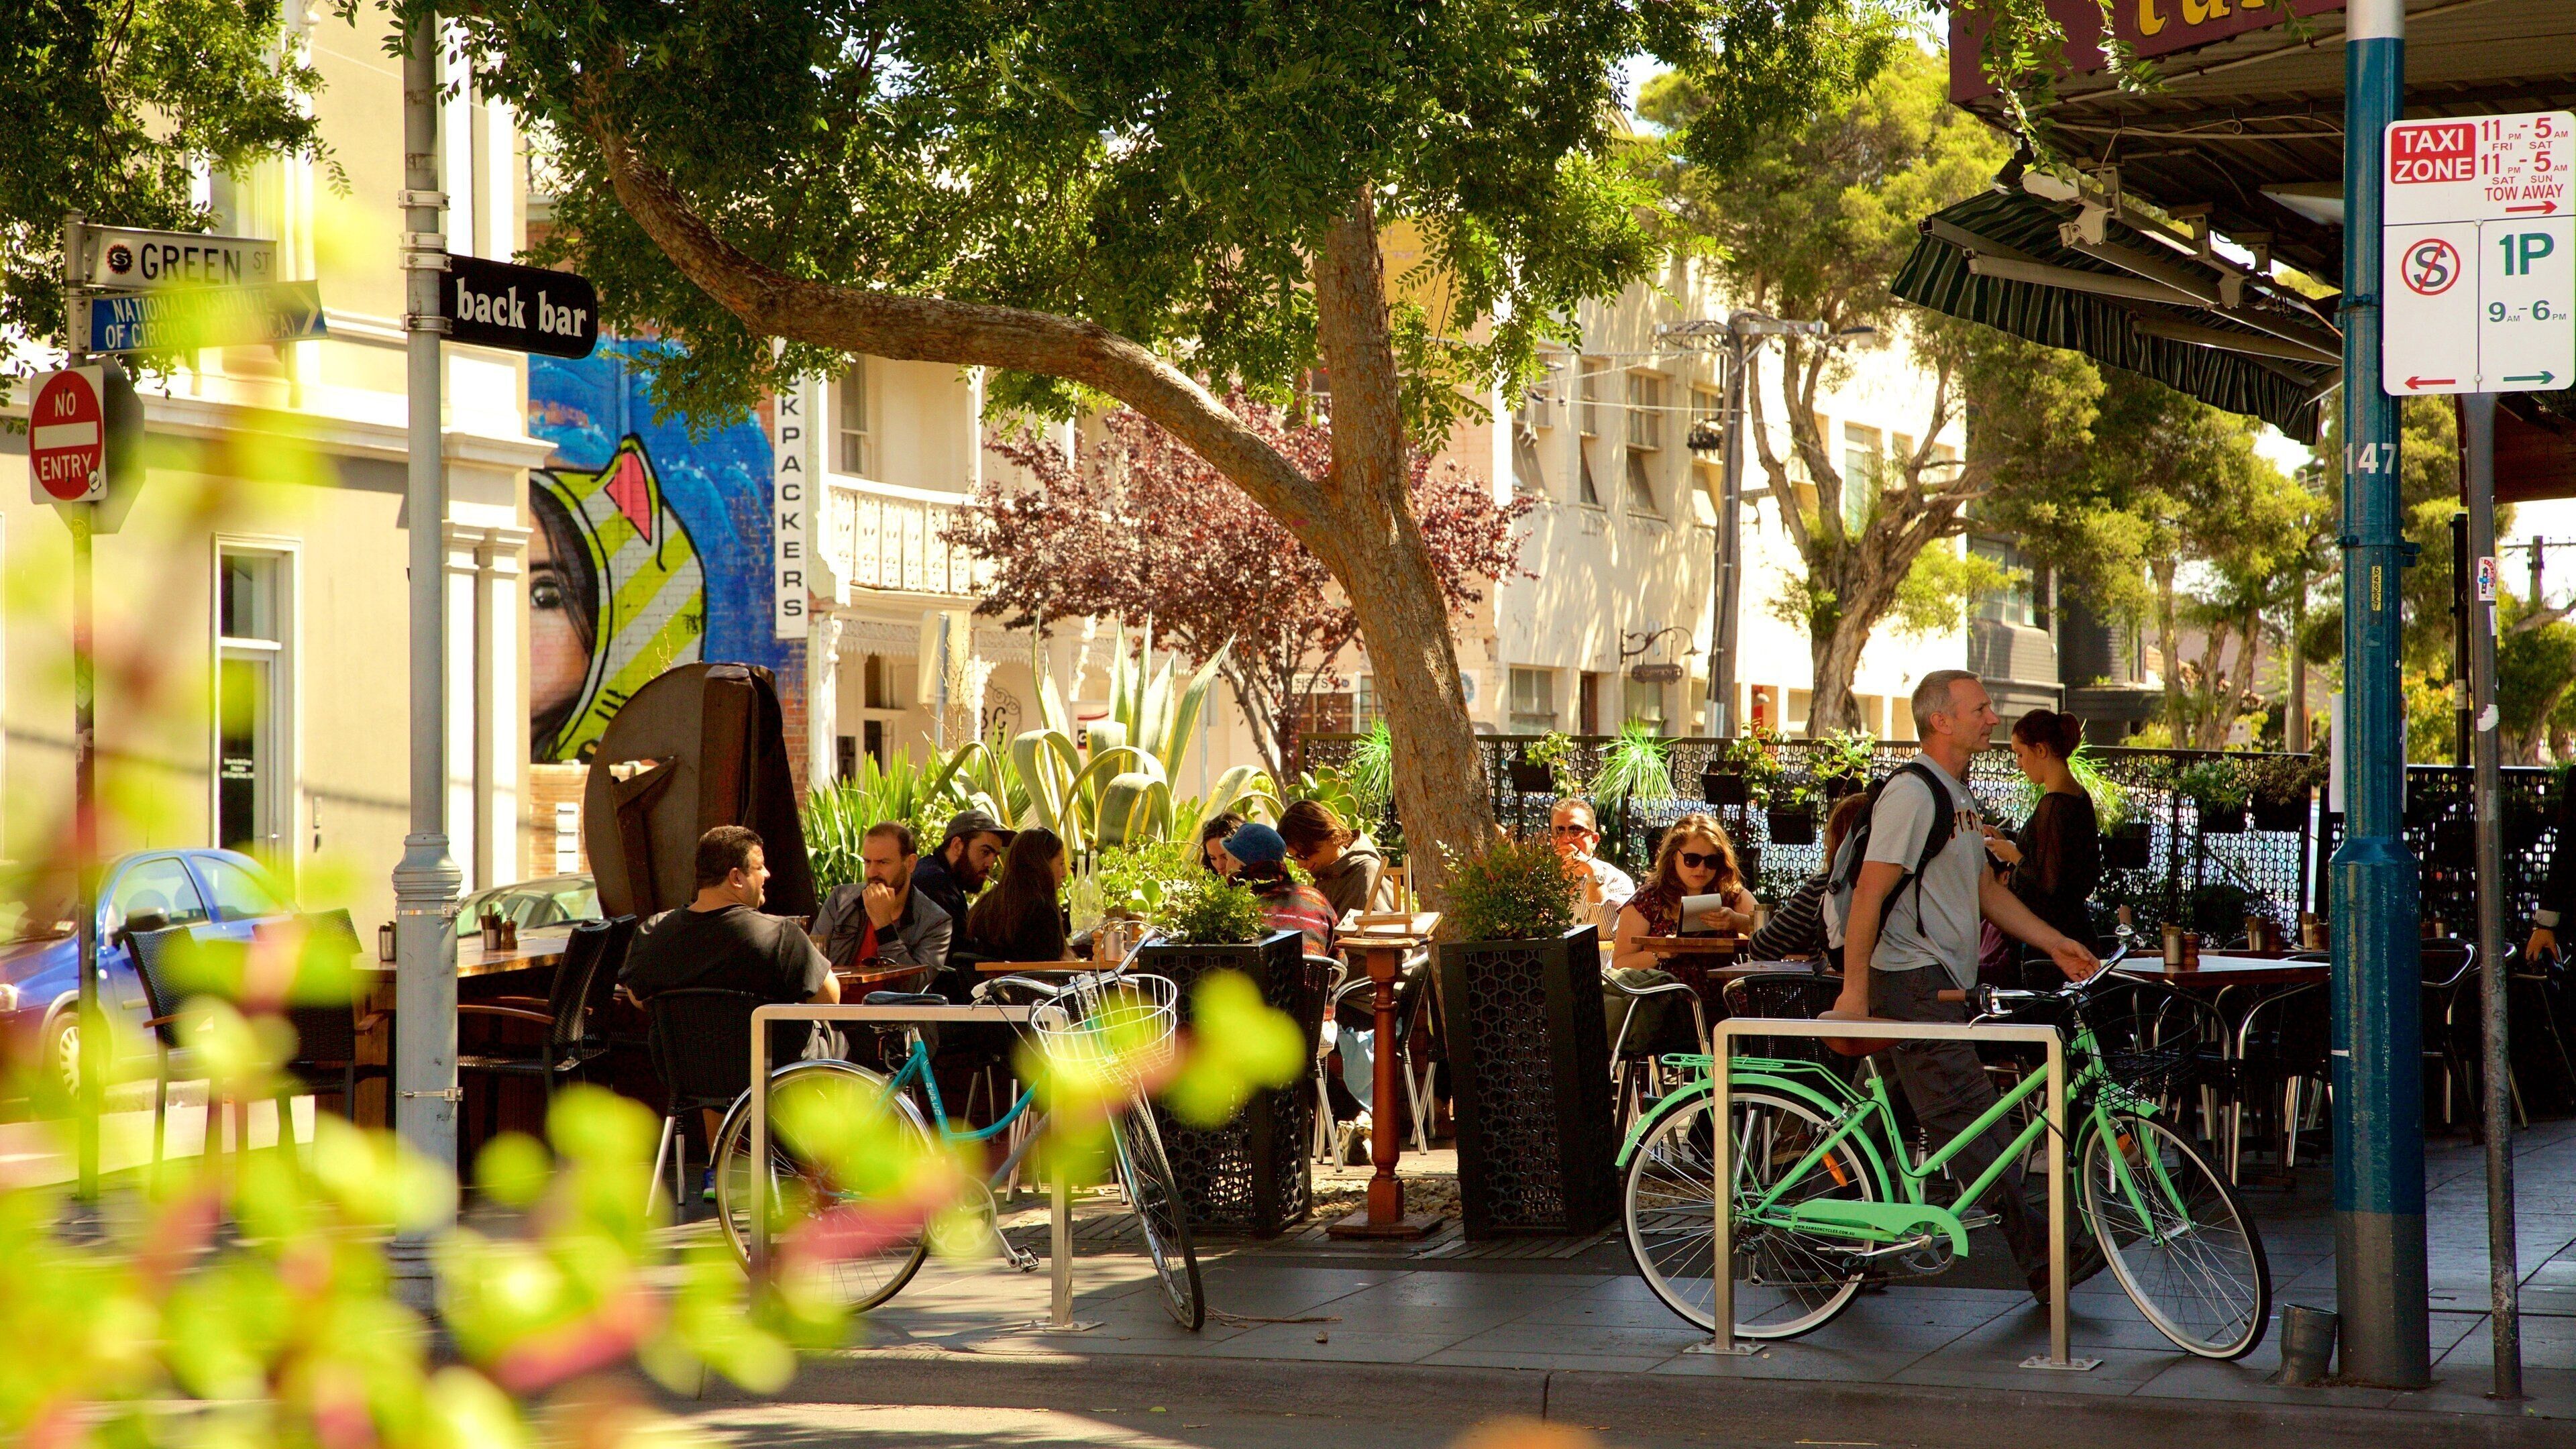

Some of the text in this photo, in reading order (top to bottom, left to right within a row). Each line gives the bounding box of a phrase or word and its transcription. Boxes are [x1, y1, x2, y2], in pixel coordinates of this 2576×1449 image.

[2400, 128, 2464, 154] TAXI
[2481, 119, 2501, 141] 11
[2534, 117, 2552, 139] 5
[2492, 141, 2553, 151] FRI SAT
[2395, 157, 2473, 182] ZONE
[2481, 153, 2500, 175] 11
[2534, 151, 2551, 172] 5
[2492, 174, 2553, 184] SAT SUN
[2484, 184, 2564, 201] TOW AWAY
[141, 242, 241, 286] GREEN
[253, 251, 271, 272] ST
[2499, 232, 2555, 276] 1P
[112, 295, 187, 323] NATIONAL
[456, 276, 587, 337] back bar
[2488, 301, 2506, 323] 9
[2507, 314, 2520, 322] AM
[2532, 300, 2550, 321] 6
[2553, 313, 2567, 321] PM
[105, 325, 126, 350] OF
[131, 319, 192, 348] CIRCUS
[199, 315, 241, 341] RTS
[55, 392, 76, 417] NO
[40, 452, 93, 481] ENTRY
[2344, 442, 2397, 474] 147
[926, 1082, 942, 1116] REPCO
[1794, 1224, 1855, 1236] WWW.SAMSONCYCLES.COM.AU
